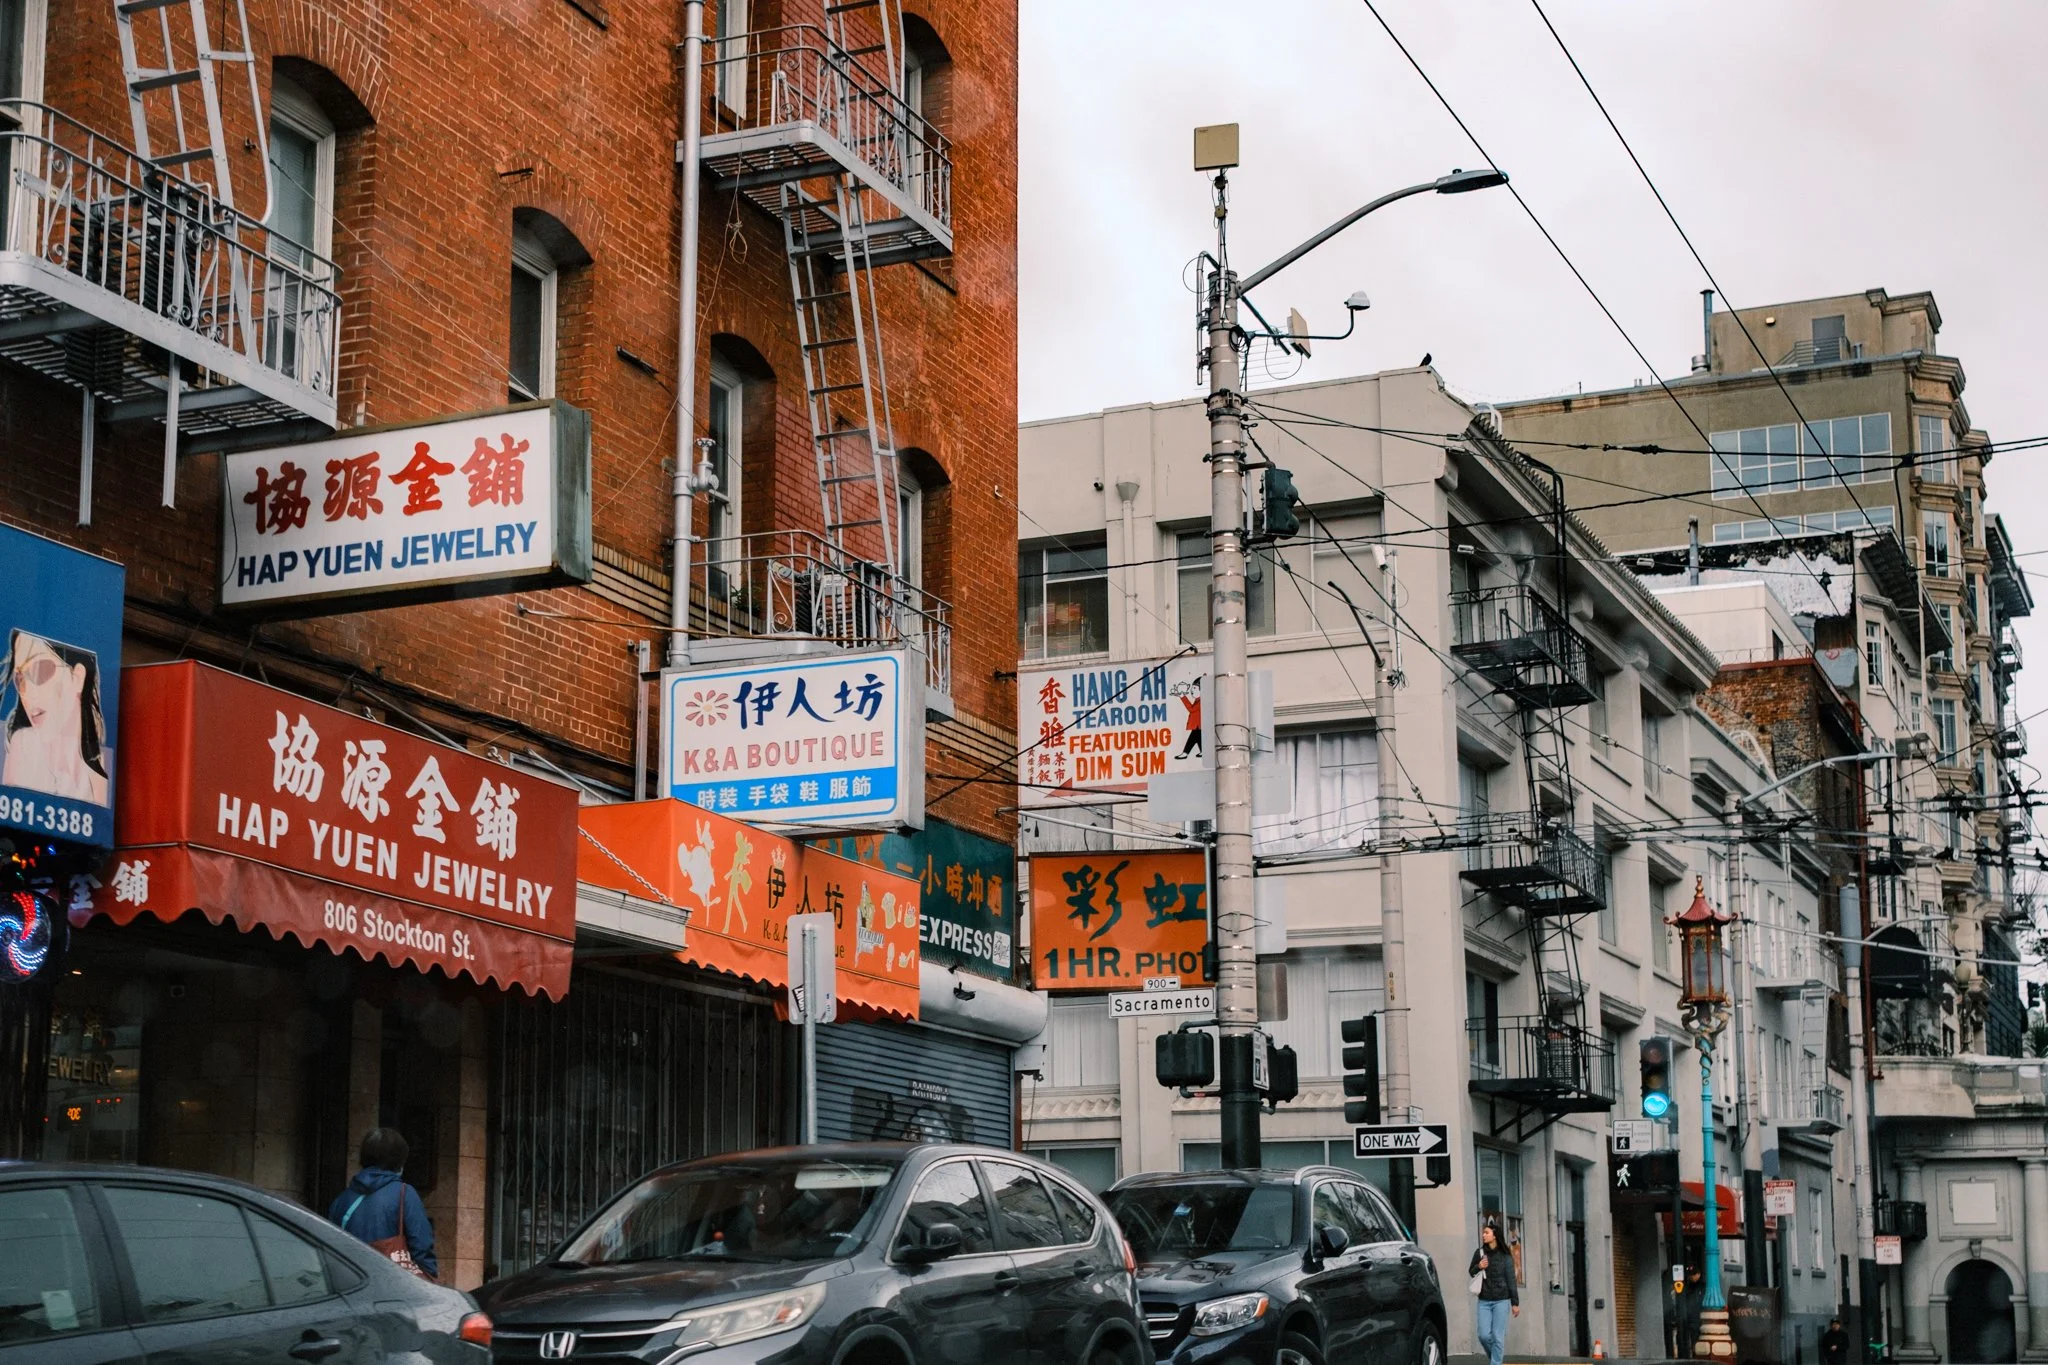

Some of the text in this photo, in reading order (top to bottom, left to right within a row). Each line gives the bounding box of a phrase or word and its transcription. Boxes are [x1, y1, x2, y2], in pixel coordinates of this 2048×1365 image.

[237, 521, 538, 588] HAP YUEN JEWELRY
[733, 673, 885, 730] 伊人坊
[1072, 665, 1167, 708] HANG AH
[1072, 703, 1168, 730] TEAROOM
[684, 731, 884, 775] K&A BOUTIQUE
[1069, 728, 1172, 755] FEATURING
[1076, 750, 1166, 782] DIM SUM
[697, 776, 872, 810] 時裝 手袋 鞋 服飾
[0, 798, 93, 837] 981-3388
[217, 793, 553, 920] HAP YUEN JEWELRY
[767, 865, 844, 930] 伊人坊
[1062, 860, 1208, 943] 彩虹
[324, 900, 475, 960] 806 Stockton St.
[919, 915, 993, 960] EXPRESS
[1136, 951, 1203, 974] PHO
[1147, 979, 1167, 988] 900
[1114, 996, 1210, 1012] Sacramento
[47, 1055, 113, 1085] EWELRY
[1363, 1134, 1420, 1148] ONE WAY
